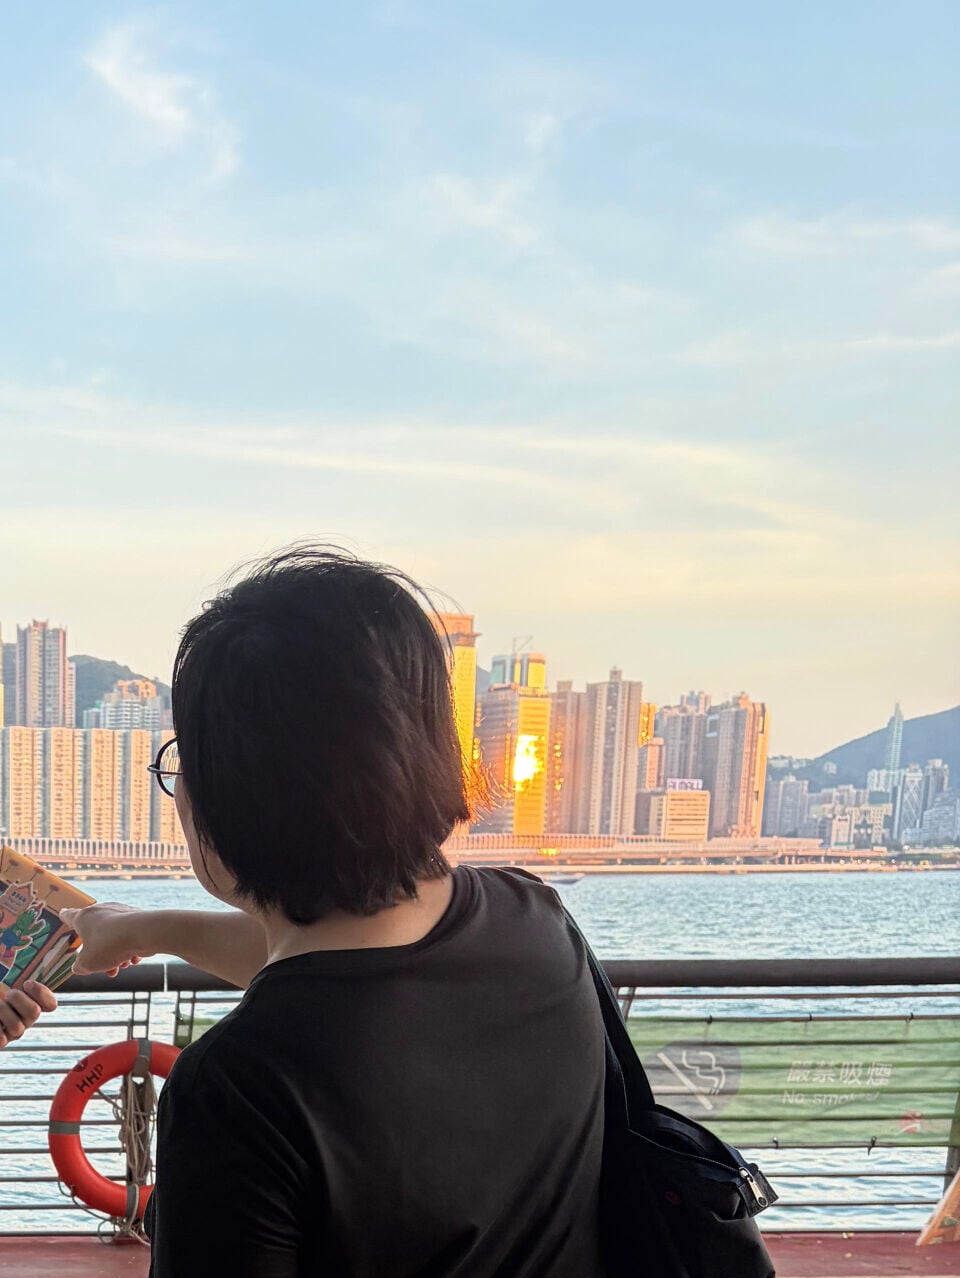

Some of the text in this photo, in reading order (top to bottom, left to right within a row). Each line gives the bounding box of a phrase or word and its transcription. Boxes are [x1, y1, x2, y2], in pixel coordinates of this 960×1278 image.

[76, 1063, 104, 1093] HHP
[786, 1060, 892, 1086] 嚴禁吸煙
[782, 1090, 805, 1104] No
